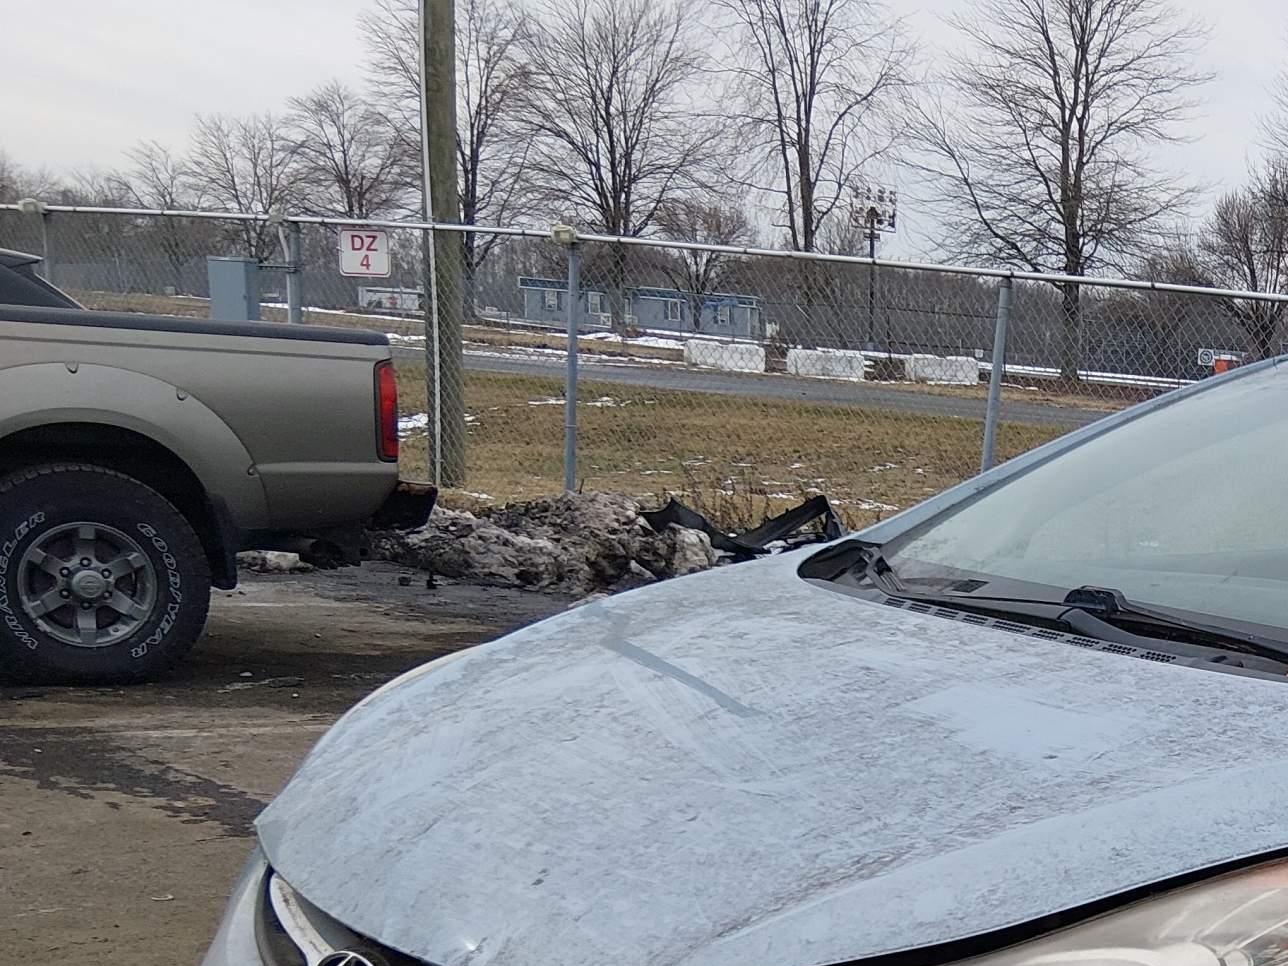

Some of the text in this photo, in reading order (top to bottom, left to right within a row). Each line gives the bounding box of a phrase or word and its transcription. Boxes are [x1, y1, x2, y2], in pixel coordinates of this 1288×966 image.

[351, 235, 378, 251] DZ
[360, 254, 371, 270] 4
[131, 523, 182, 657] GOODYEAR
